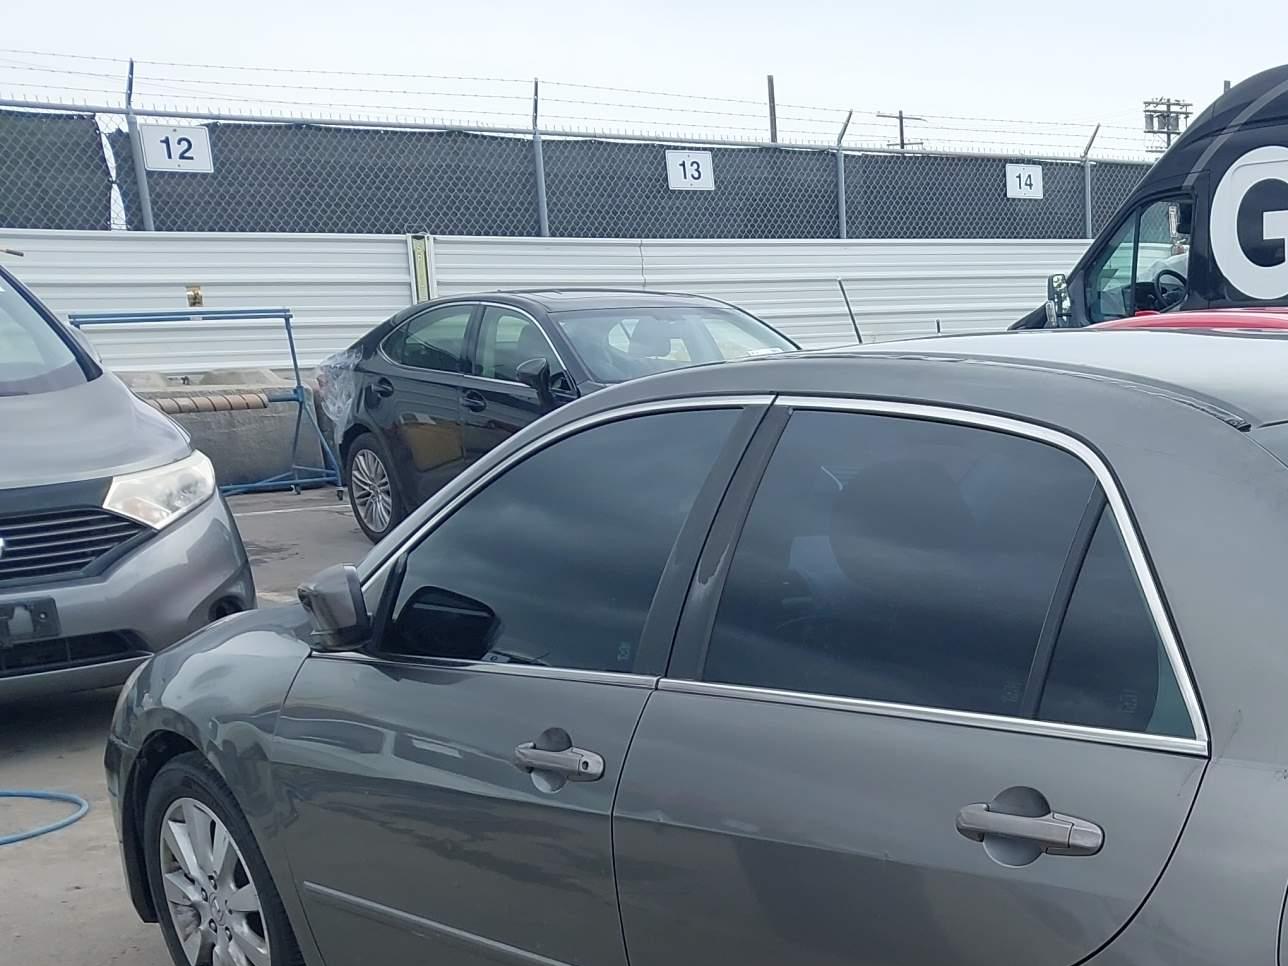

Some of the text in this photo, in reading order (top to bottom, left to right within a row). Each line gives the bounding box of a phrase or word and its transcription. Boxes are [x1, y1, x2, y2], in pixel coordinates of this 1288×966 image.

[159, 135, 194, 161] 12
[678, 160, 702, 181] 13
[1015, 173, 1034, 190] 14
